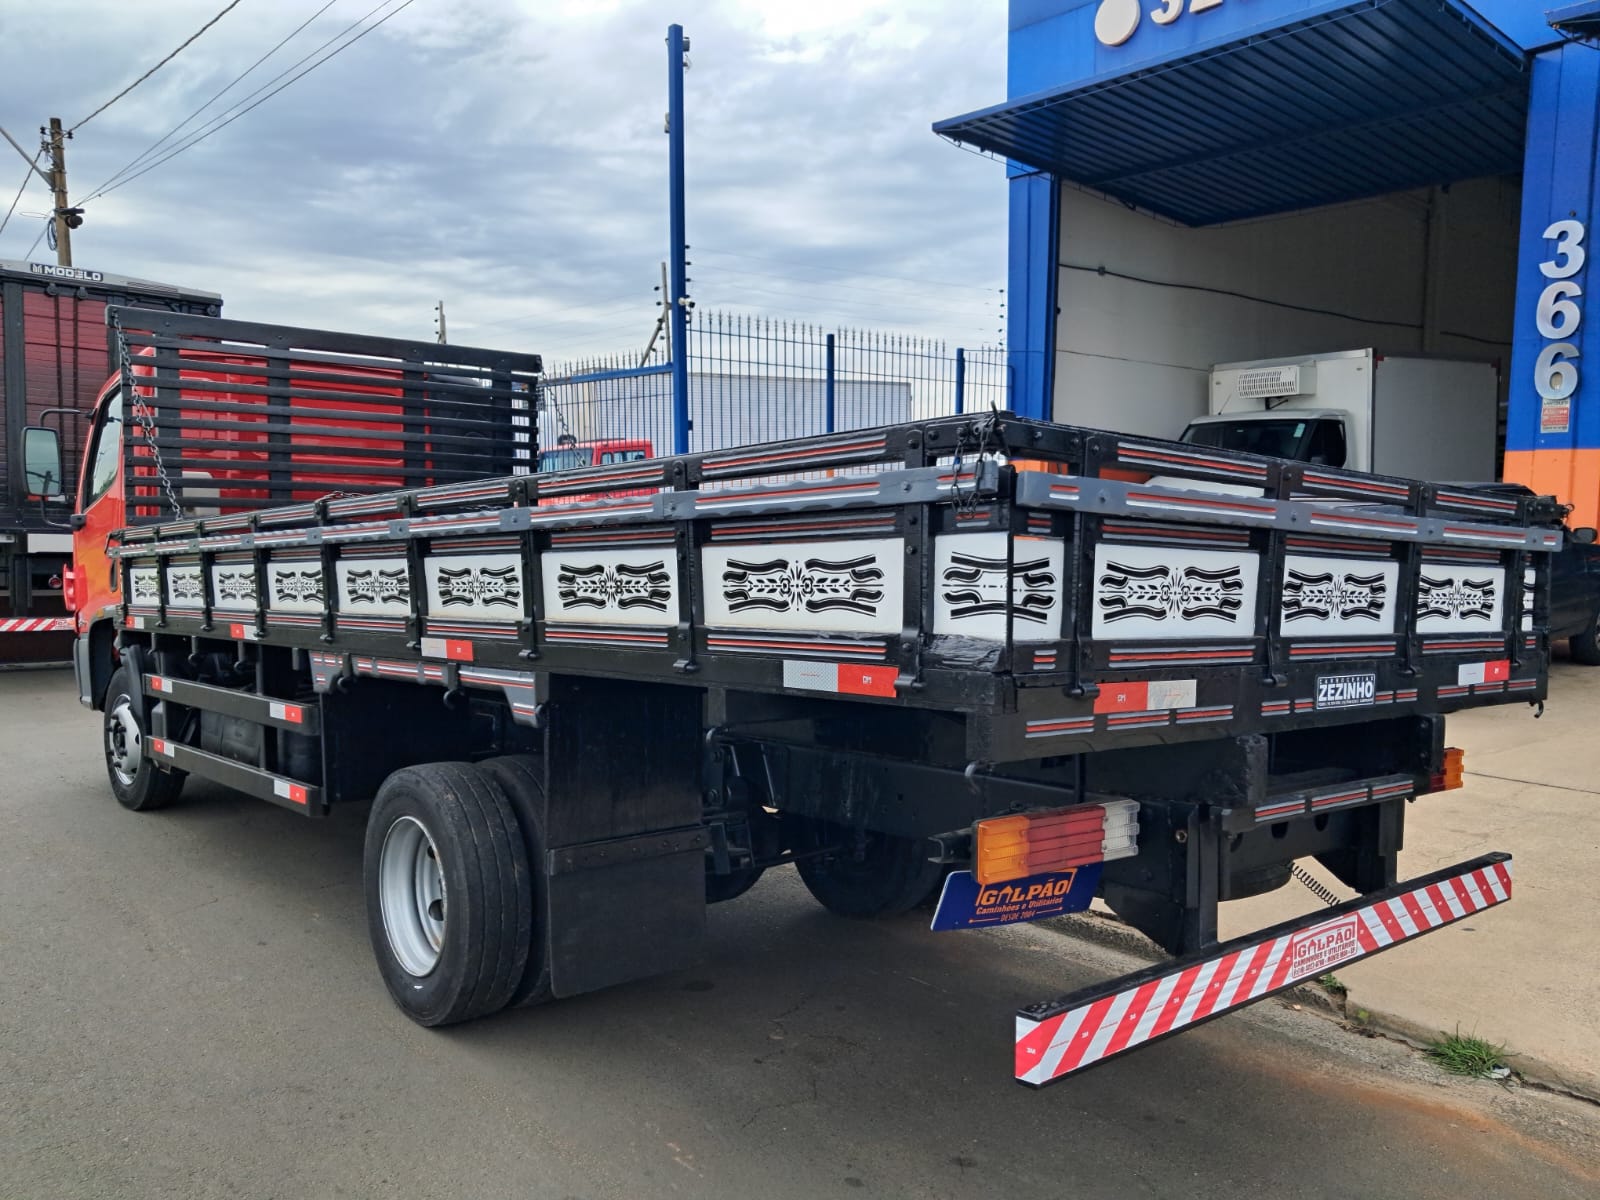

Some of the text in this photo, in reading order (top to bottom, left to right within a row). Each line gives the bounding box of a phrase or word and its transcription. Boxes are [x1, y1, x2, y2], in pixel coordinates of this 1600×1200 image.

[44, 266, 101, 280] MODELO
[1534, 219, 1586, 400] 366
[1318, 681, 1373, 701] ZEZINHO
[981, 879, 1070, 906] GALPÃO
[1297, 928, 1352, 958] GALPÃO
